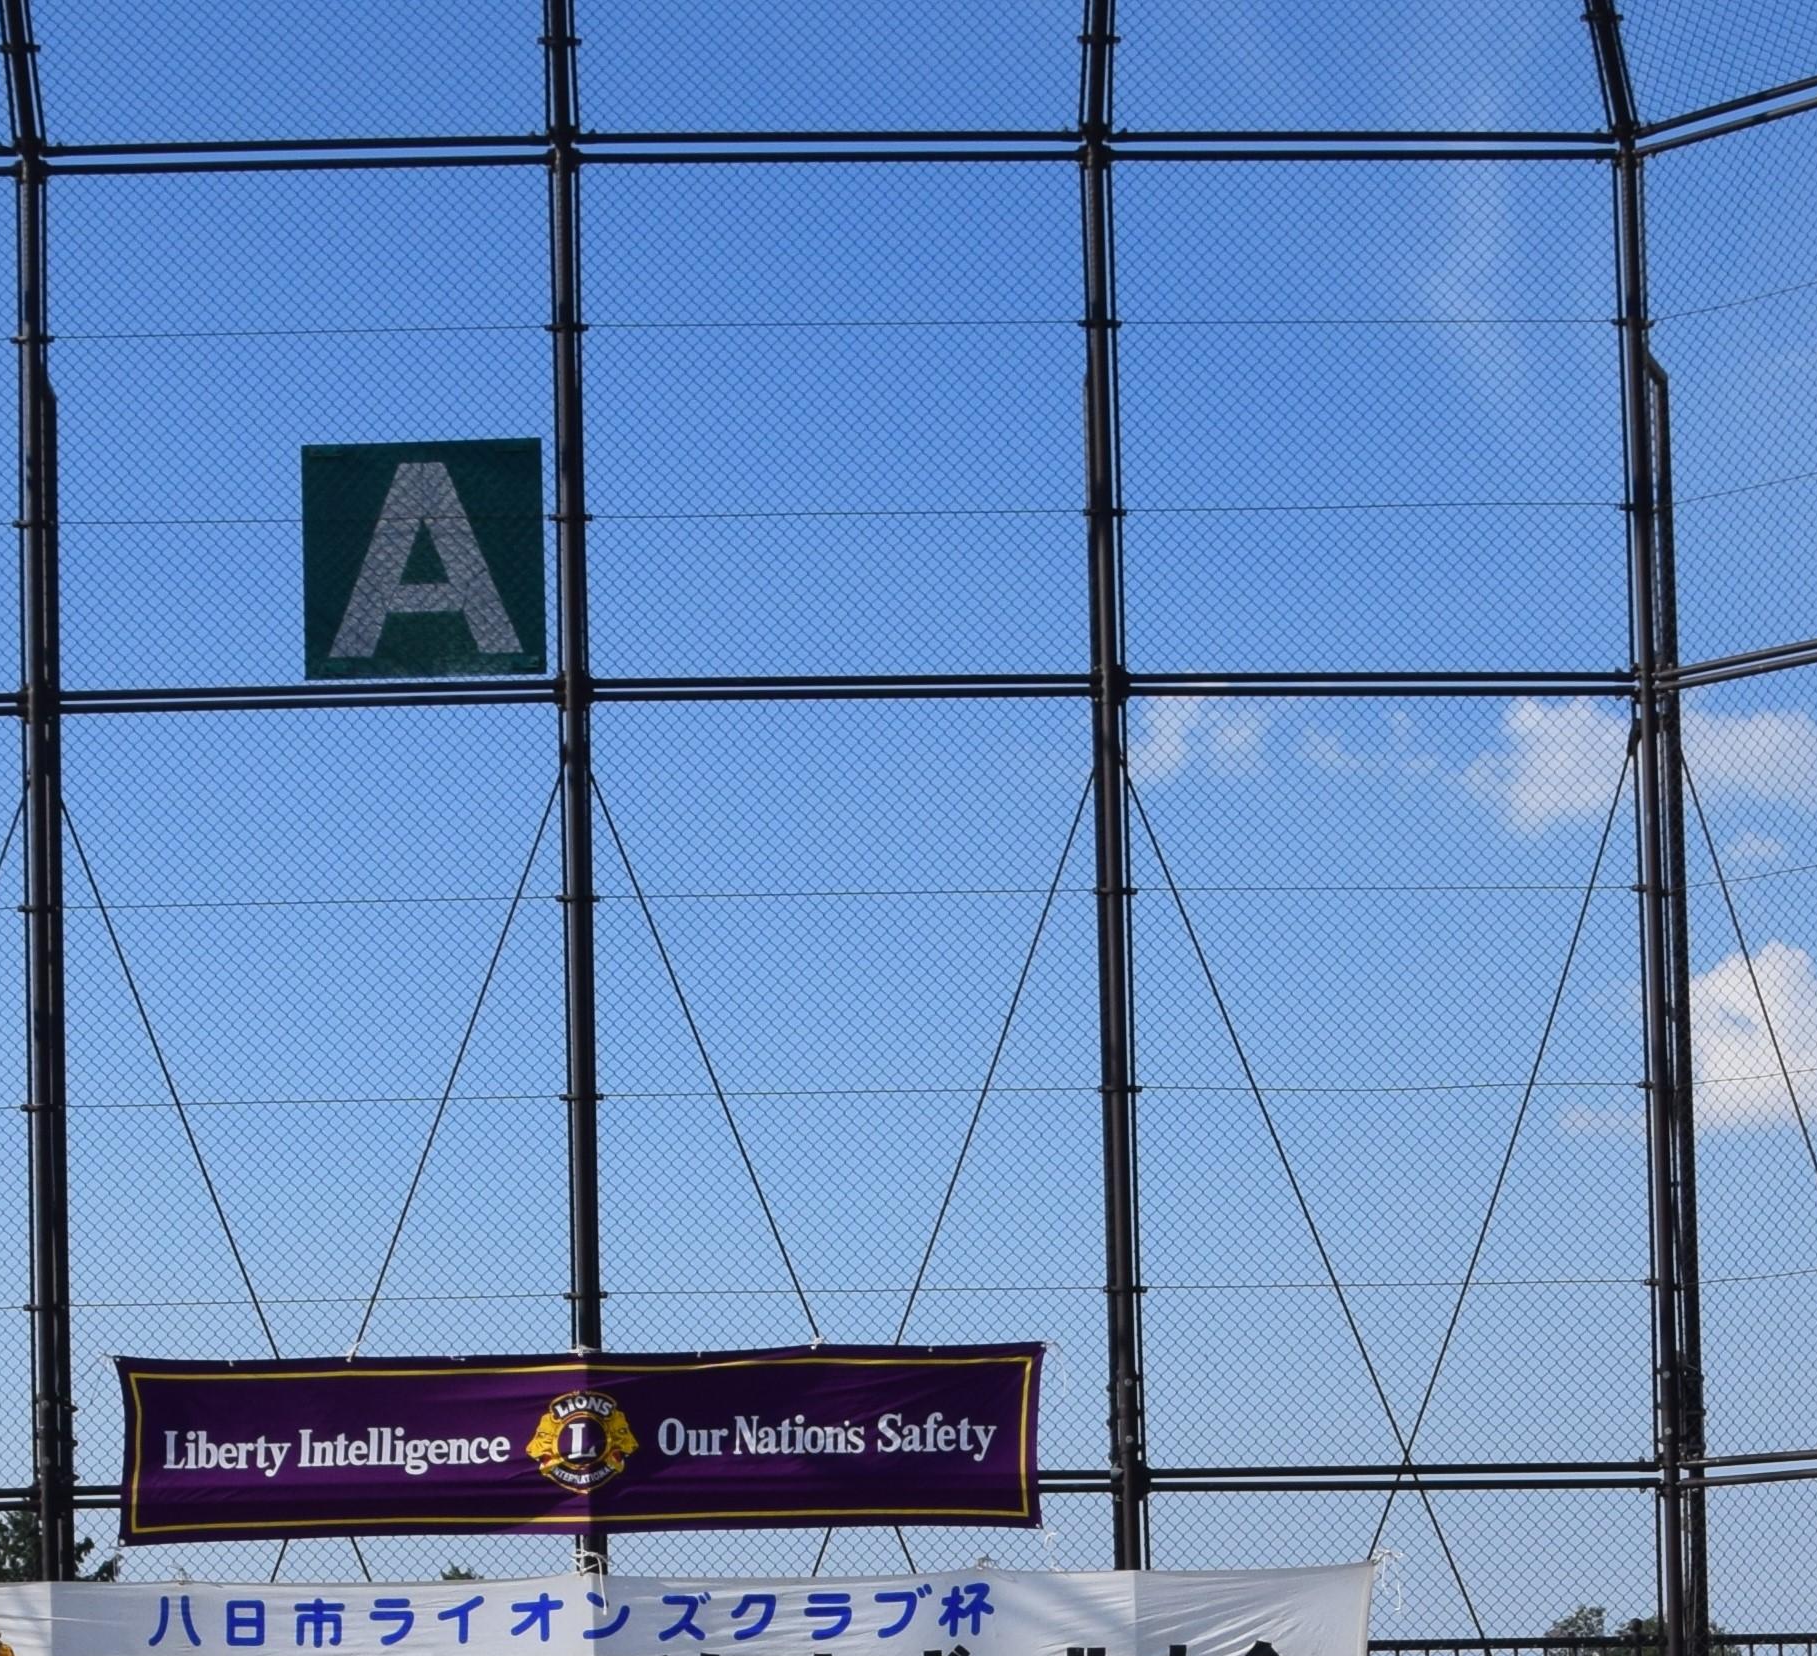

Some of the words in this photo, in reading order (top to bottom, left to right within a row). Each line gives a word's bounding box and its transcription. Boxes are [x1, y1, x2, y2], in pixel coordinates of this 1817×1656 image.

[329, 462, 523, 658] A
[554, 1396, 613, 1417] LIONS
[163, 1430, 291, 1477] Liberty
[298, 1427, 510, 1475] Intelligence
[568, 1423, 597, 1459] L
[658, 1418, 728, 1457] Our
[877, 1412, 998, 1462] Safety
[148, 1582, 996, 1649] 八日市ライオンズクラブ杯
